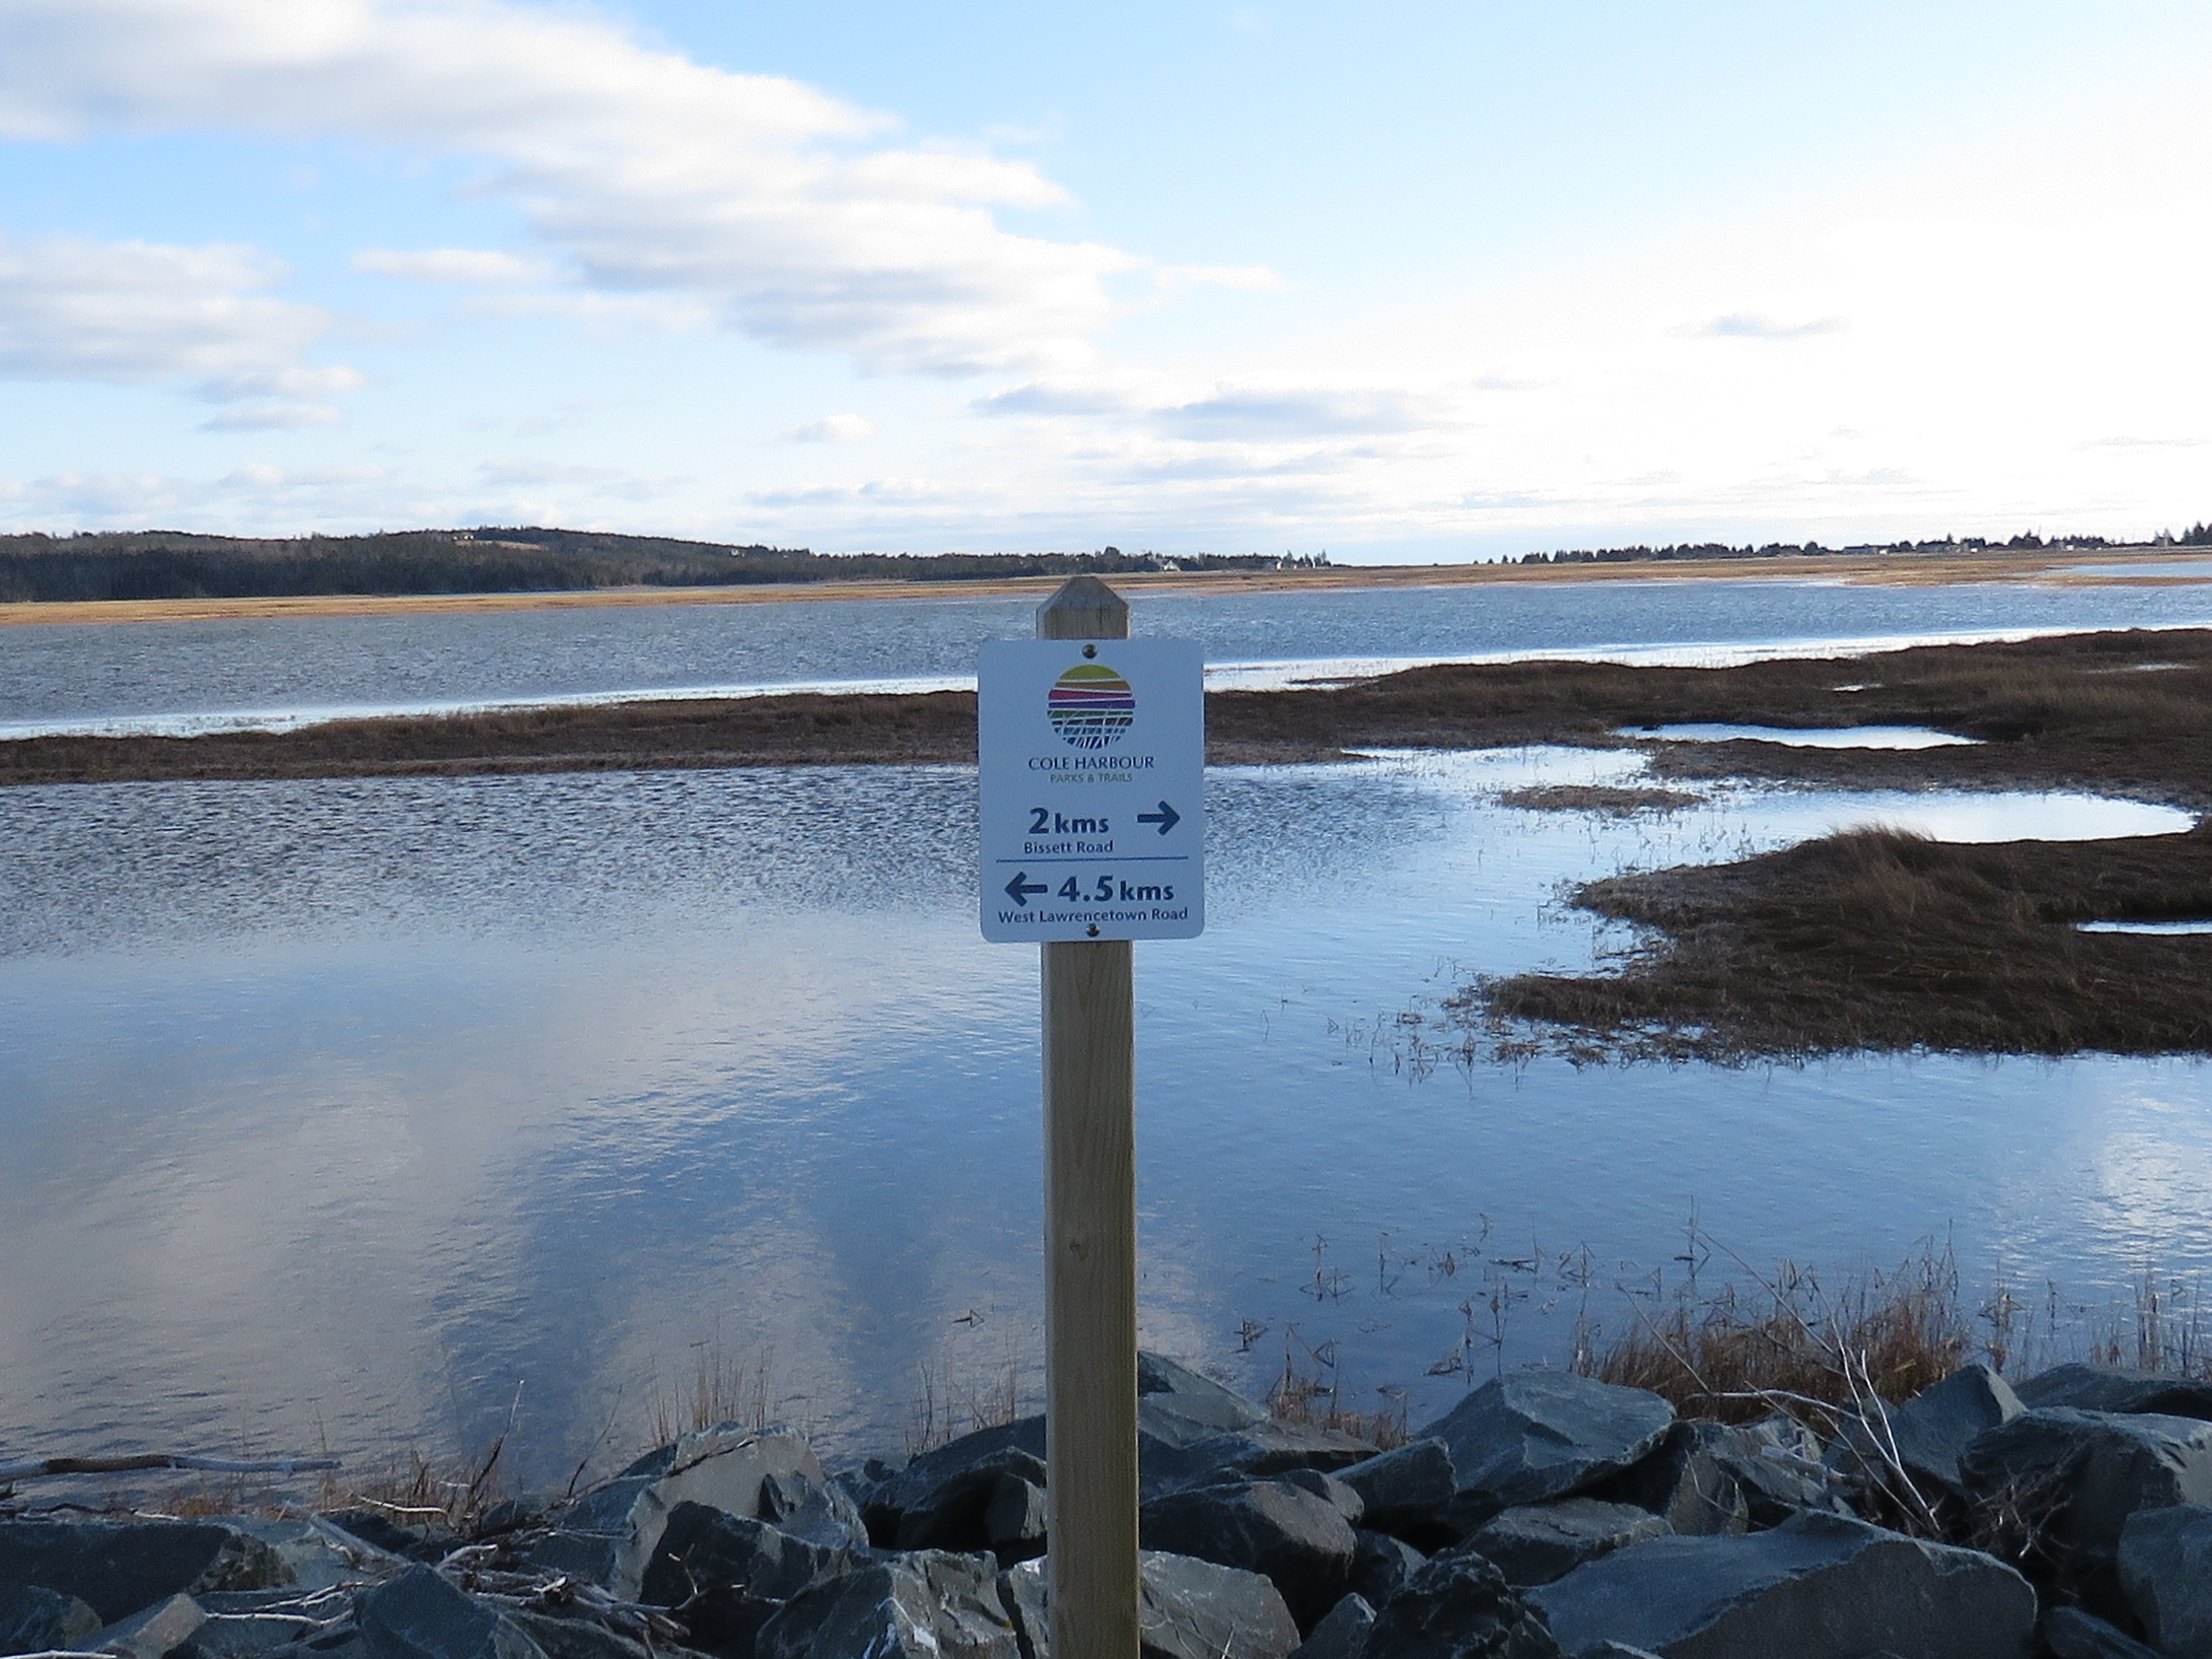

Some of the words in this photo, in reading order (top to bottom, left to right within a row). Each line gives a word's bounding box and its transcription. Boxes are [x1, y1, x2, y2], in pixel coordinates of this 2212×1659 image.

[1028, 757, 1069, 770] COLE
[1075, 756, 1154, 769] HARBOUR
[1050, 773, 1083, 783] PARKS
[1088, 773, 1094, 782] &
[1099, 773, 1133, 782] TRAILS
[1024, 842, 1071, 854] Bissett
[1077, 841, 1113, 853] Road
[998, 911, 1035, 923] West
[1039, 909, 1146, 923] Lawrencetown
[1152, 907, 1189, 920] Road
